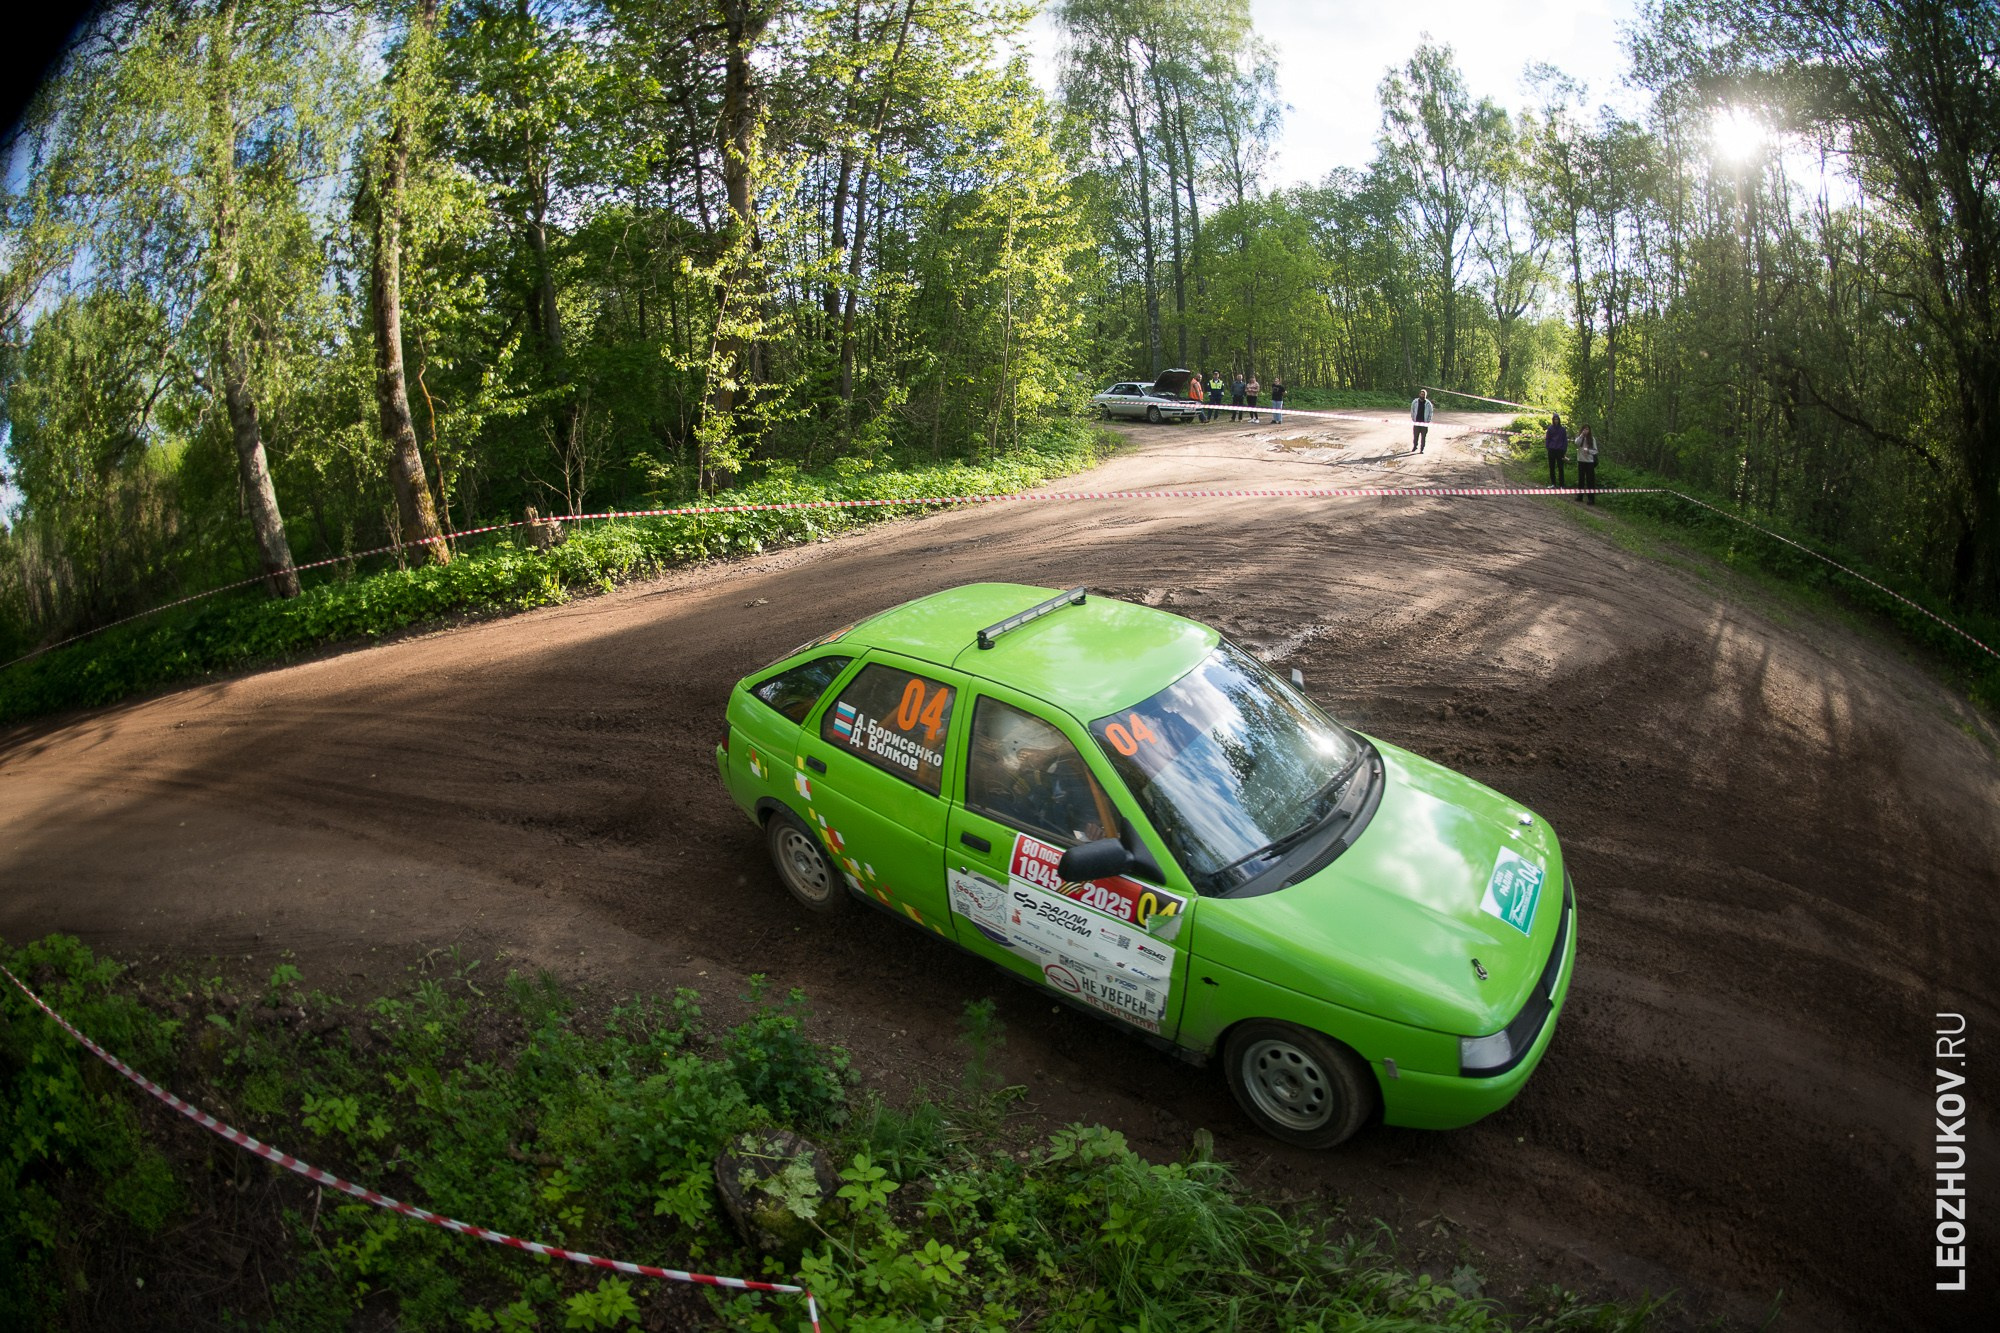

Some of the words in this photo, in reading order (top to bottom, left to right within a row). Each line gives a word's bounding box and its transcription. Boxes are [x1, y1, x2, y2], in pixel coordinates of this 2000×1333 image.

[897, 679, 949, 740] 04
[1105, 713, 1157, 756] 04
[850, 728, 864, 748] Д.
[868, 735, 919, 771] Волков
[1022, 839, 1039, 862] 80
[1517, 859, 1541, 885] 04
[1019, 857, 1063, 890] 1945
[1080, 883, 1134, 920] 2025
[1036, 909, 1092, 938] РОССИИ
[1040, 901, 1088, 926] РАЛЛИ
[1082, 976, 1097, 995] НЕ
